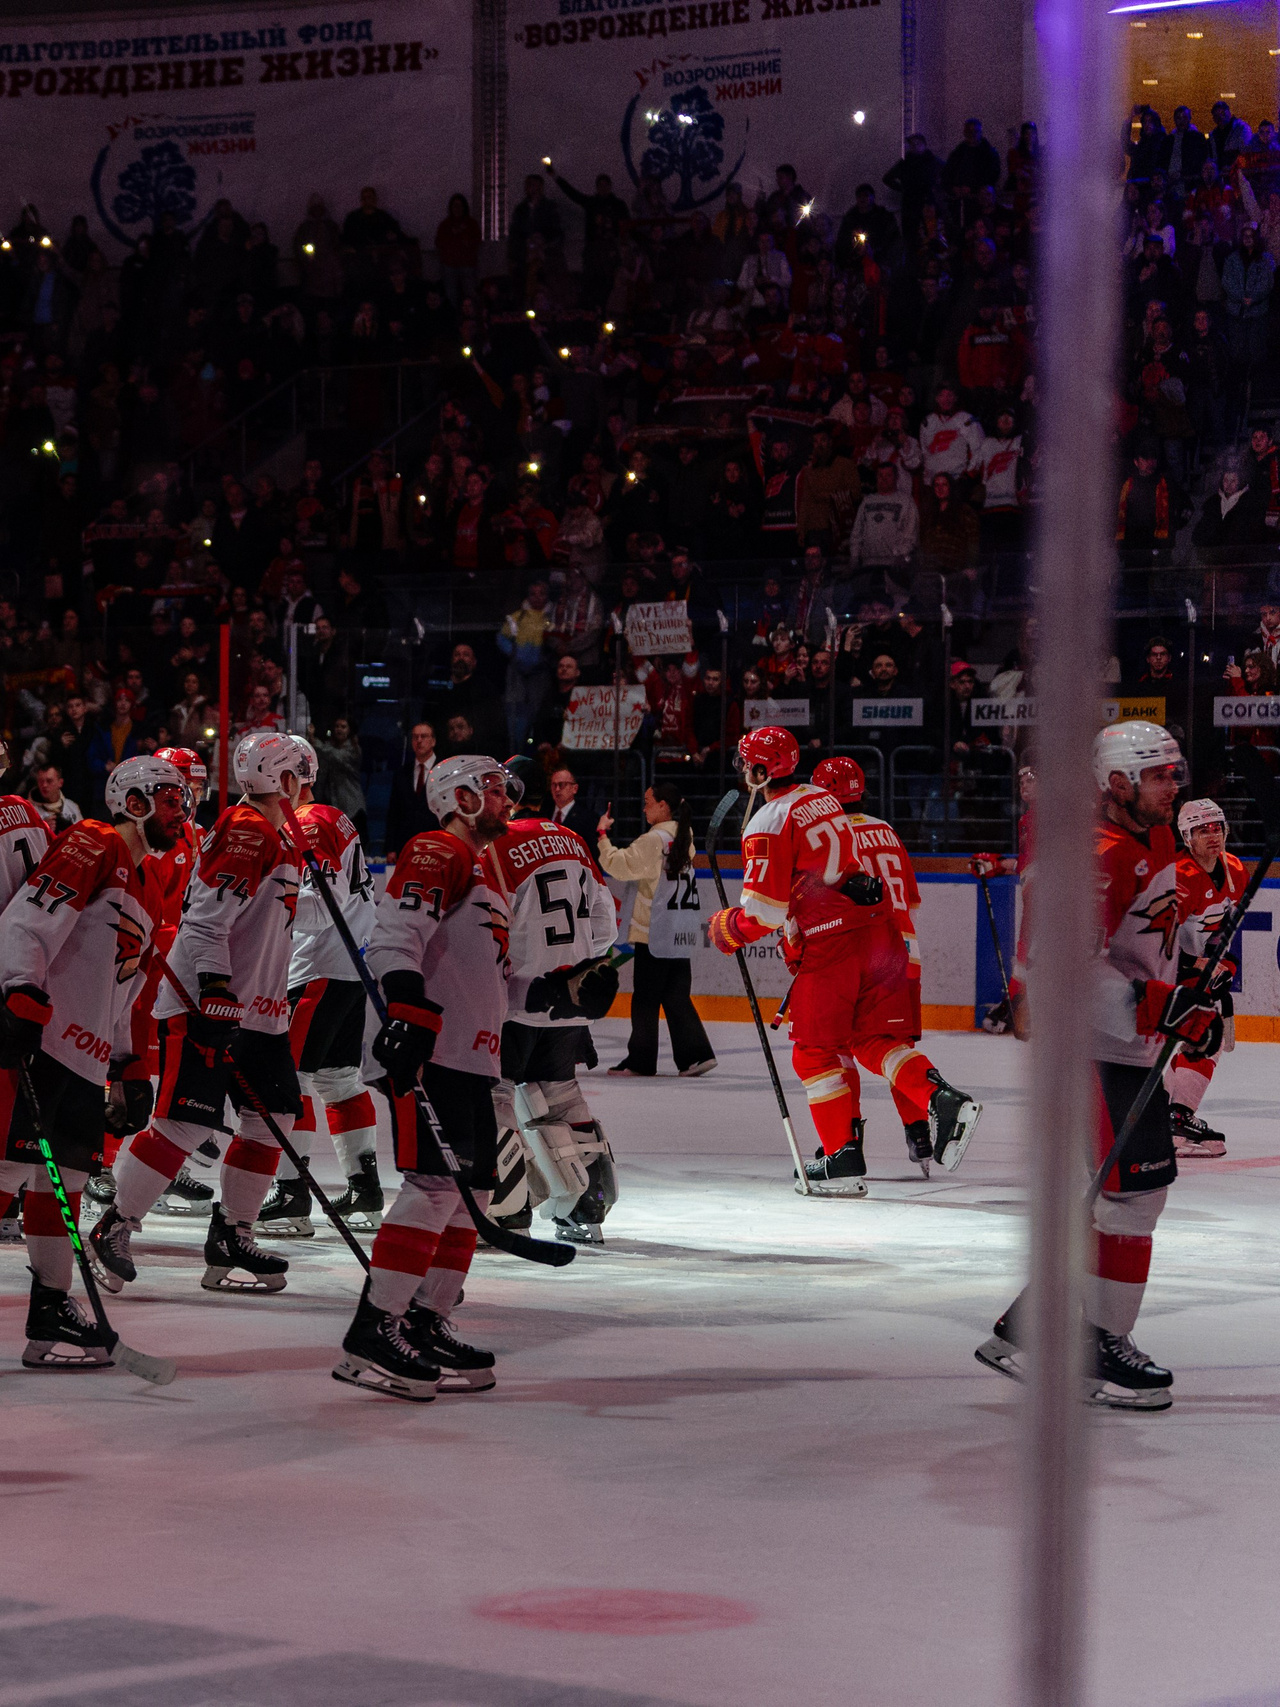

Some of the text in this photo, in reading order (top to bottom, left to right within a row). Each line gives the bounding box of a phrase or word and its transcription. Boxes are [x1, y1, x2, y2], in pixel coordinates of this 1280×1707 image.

[298, 19, 373, 44] ФОНД
[514, 0, 750, 48] «ВОЗРОЖДЕНИЕ
[260, 42, 439, 83] ЖИЗНИ»
[663, 58, 782, 87] ВОЗРОЖДЕНИЕ
[714, 78, 782, 101] ЖИЗНИ
[591, 706, 612, 717] YOU
[861, 705, 913, 719] SIBUR
[1122, 707, 1158, 717] БАНК
[571, 717, 607, 732] THANK
[240, 780, 254, 792] 74
[225, 845, 260, 859] G-DRIVE
[804, 813, 866, 887] 27
[743, 859, 769, 883] 27
[26, 872, 80, 915] 17
[215, 873, 251, 907] 74
[400, 880, 446, 923] 51
[804, 917, 843, 937] WARRIOR
[205, 1003, 244, 1019] WARR
[61, 1023, 112, 1065] FONB
[178, 1096, 217, 1113] G-ENERGY
[413, 1085, 462, 1172] TRUE
[38, 1138, 83, 1251] SOYUZ
